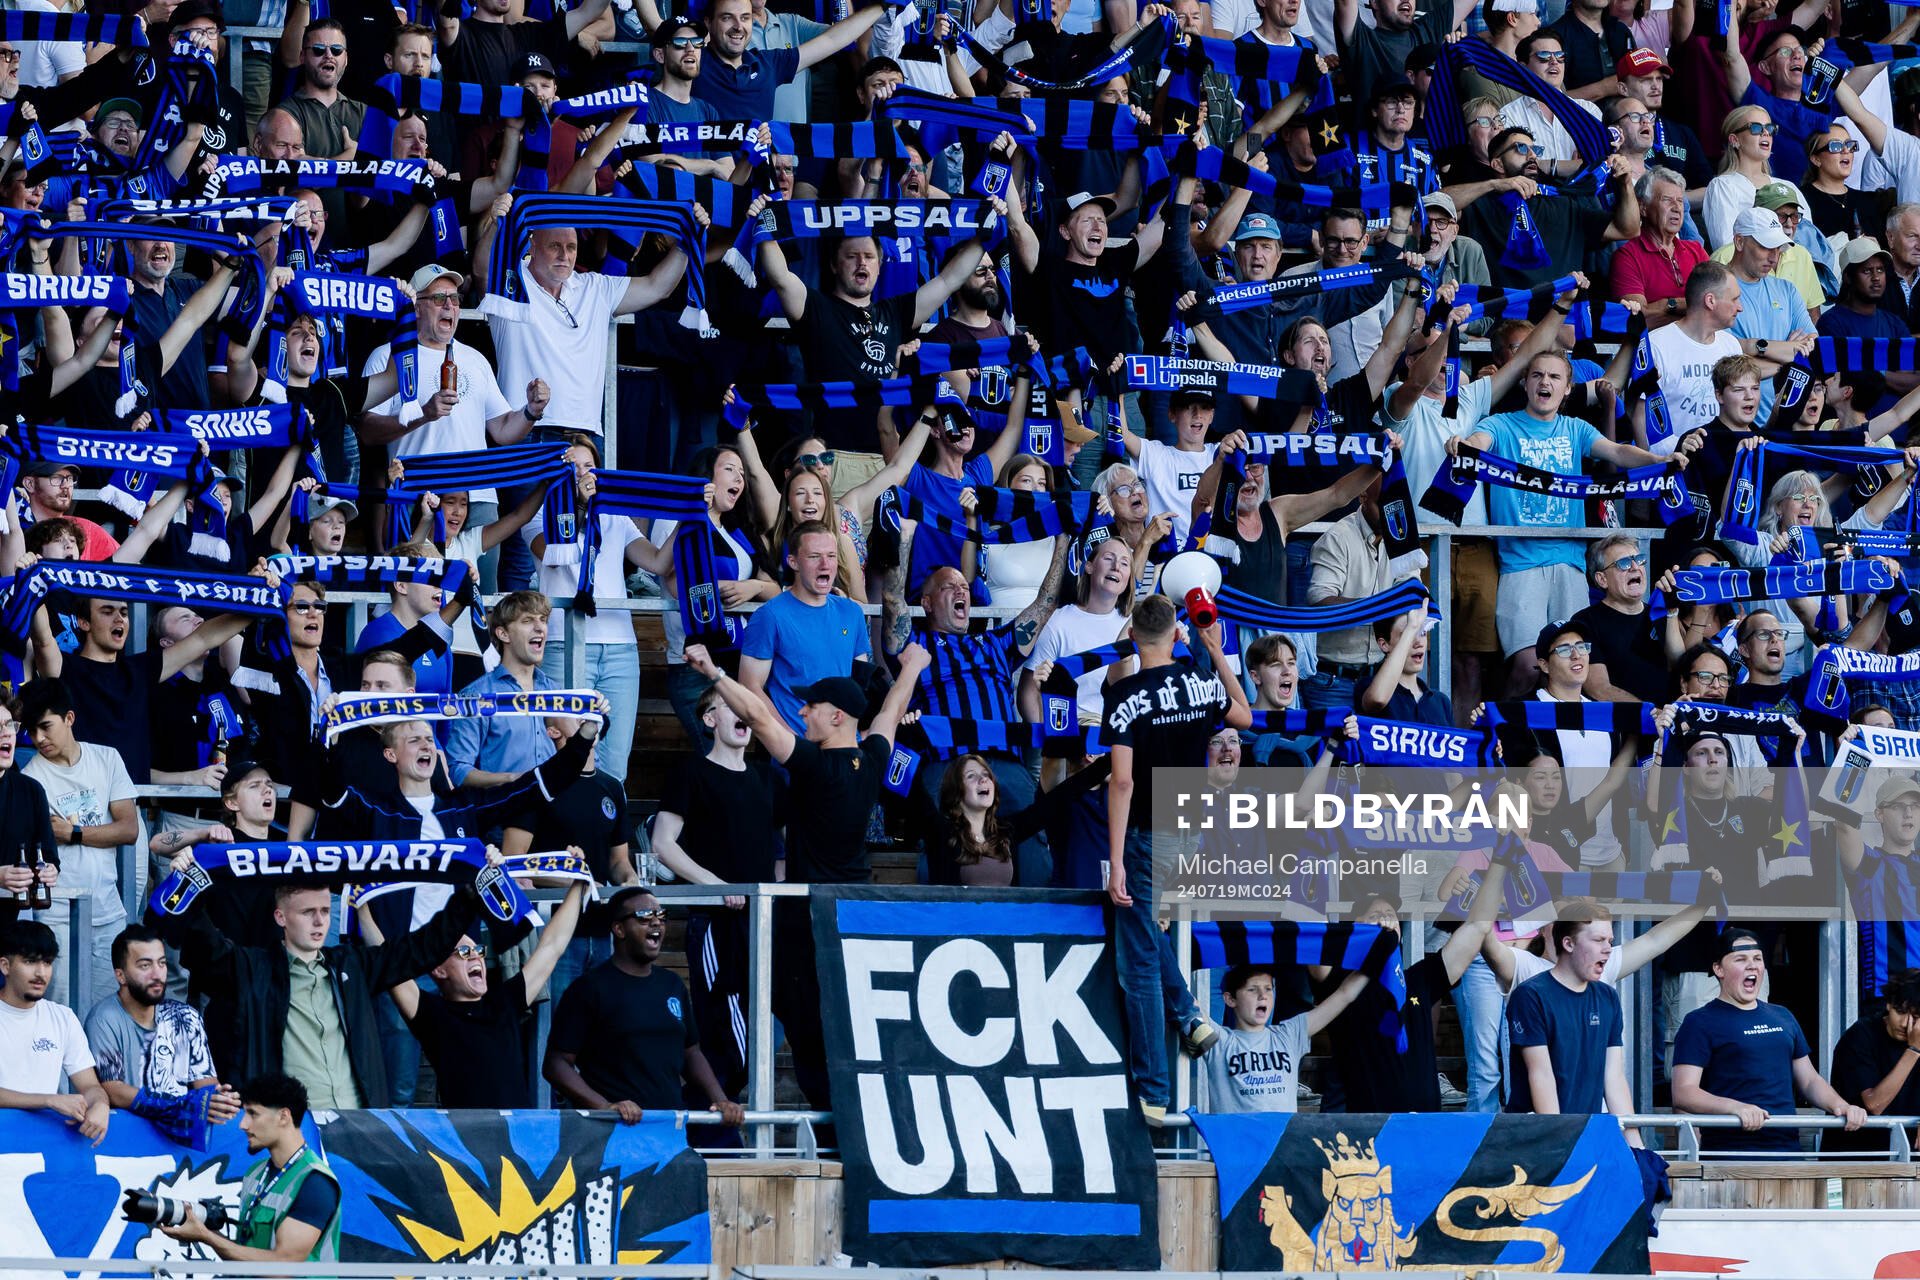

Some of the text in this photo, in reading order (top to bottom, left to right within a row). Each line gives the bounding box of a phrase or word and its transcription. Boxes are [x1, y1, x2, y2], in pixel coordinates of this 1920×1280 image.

[528, 55, 542, 67] NY
[1814, 60, 1838, 77] SIRIUS
[657, 123, 689, 143] ÄR
[203, 159, 291, 199] UPPSALA
[6, 272, 114, 300] SIRIUS
[303, 277, 394, 313] SIRIUS
[1160, 370, 1218, 388] Uppsala
[186, 409, 272, 440] SIRIUS
[1030, 426, 1051, 434] SIRIUS
[57, 436, 179, 468] SIRIUS
[1179, 474, 1200, 489] 19
[1452, 455, 1544, 490] UPPSALA
[1585, 475, 1676, 496] BLÅSVAR
[268, 555, 445, 577] UPPSALA
[1676, 557, 1896, 602] SIRIUS
[690, 583, 713, 597] SIRIUS
[327, 698, 426, 728] ARKENS
[1109, 689, 1153, 734] sons
[1156, 675, 1180, 711] of
[1369, 724, 1468, 763] SIRIUS
[1871, 734, 1920, 758] SIRI
[1847, 751, 1870, 769] SIRIUS
[840, 937, 1122, 1068] FCK
[1228, 1050, 1292, 1077] SIRIUS
[1242, 1073, 1283, 1087] Uppsala
[857, 1072, 1129, 1196] UNT
